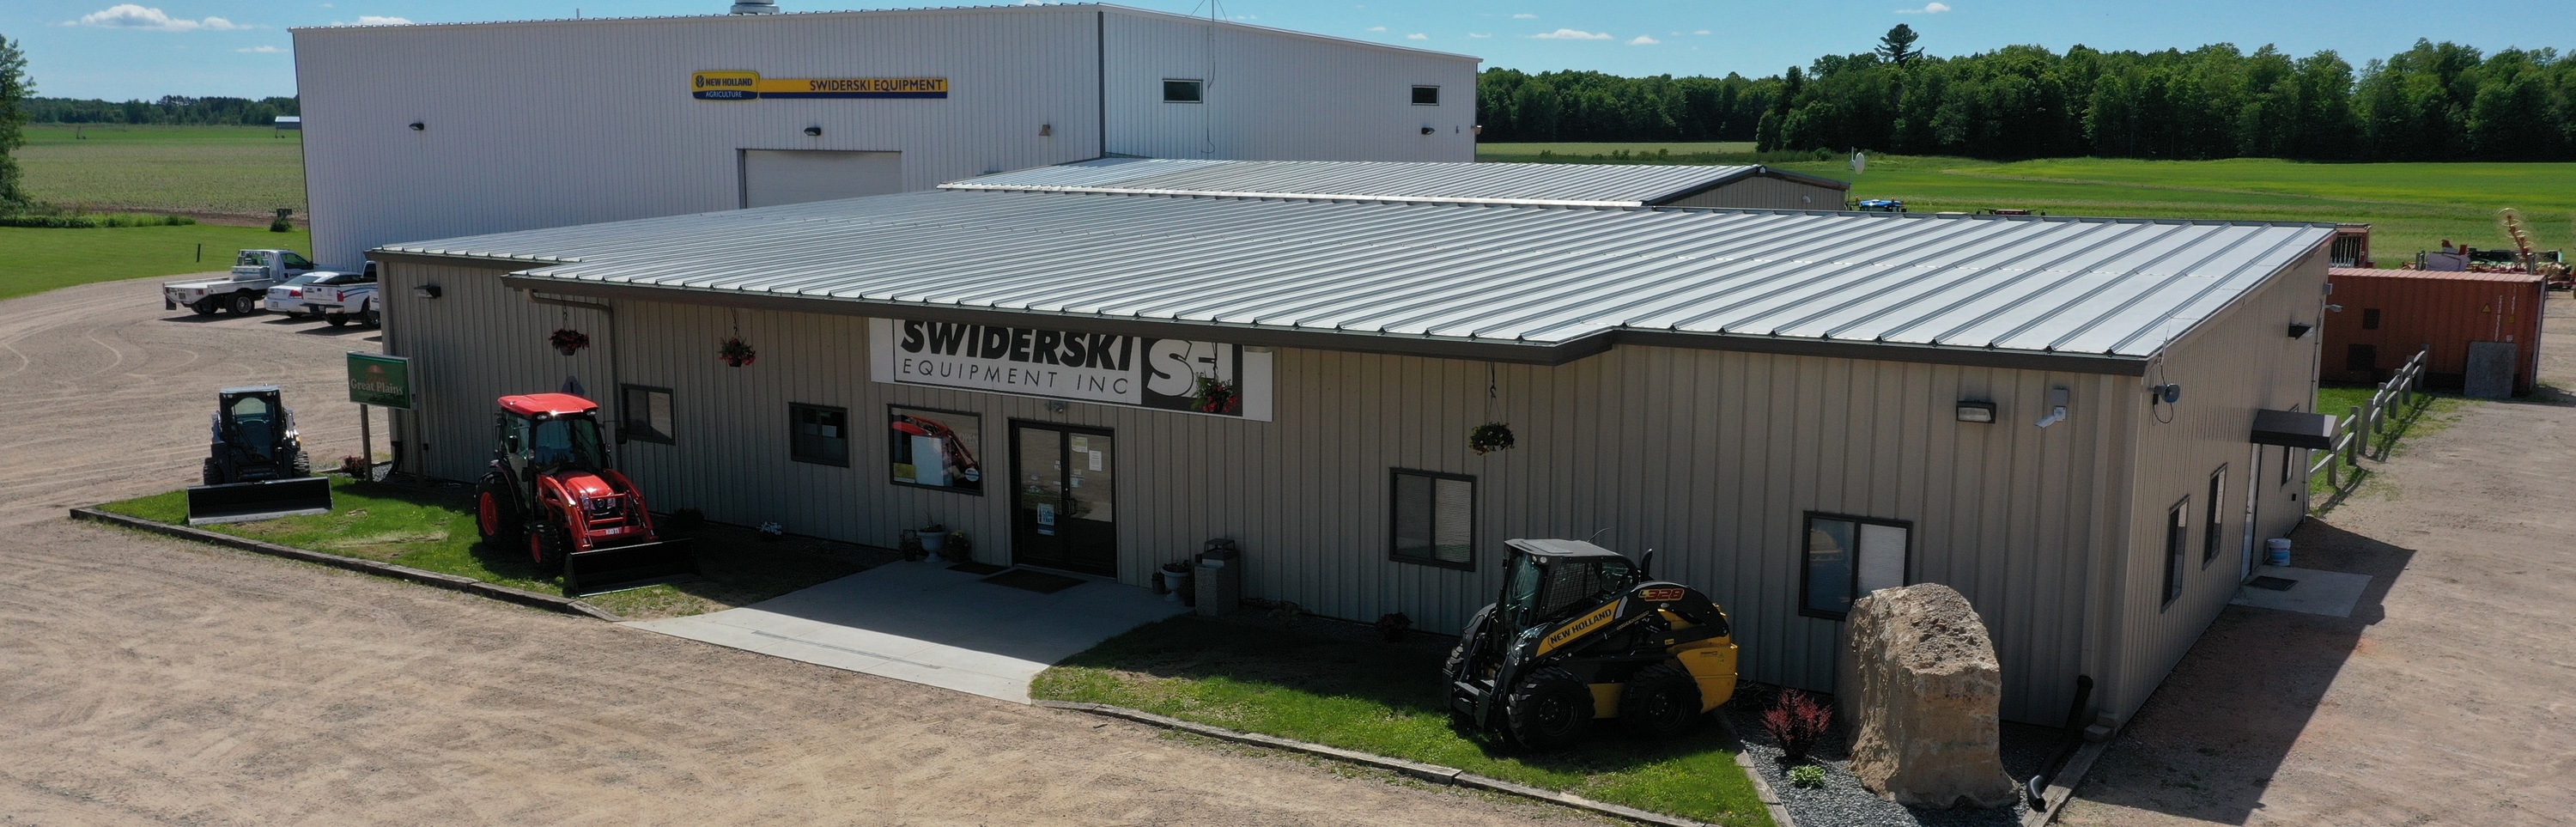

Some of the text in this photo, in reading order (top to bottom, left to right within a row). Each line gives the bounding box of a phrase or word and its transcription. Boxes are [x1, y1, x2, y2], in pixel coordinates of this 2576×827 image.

[705, 77, 753, 87] NEW HOLLAND
[810, 79, 944, 91] SWIDERSKI EQUIPMENT
[705, 90, 743, 99] AGRICULTURE
[900, 320, 1133, 372] SWIDERSKI
[902, 358, 1128, 395] EQUIPMENT INC
[350, 378, 404, 395] Great Plains
[958, 433, 979, 445] OPEN
[1549, 628, 1571, 645] NEW
[1571, 608, 1612, 634] HOLLAND
